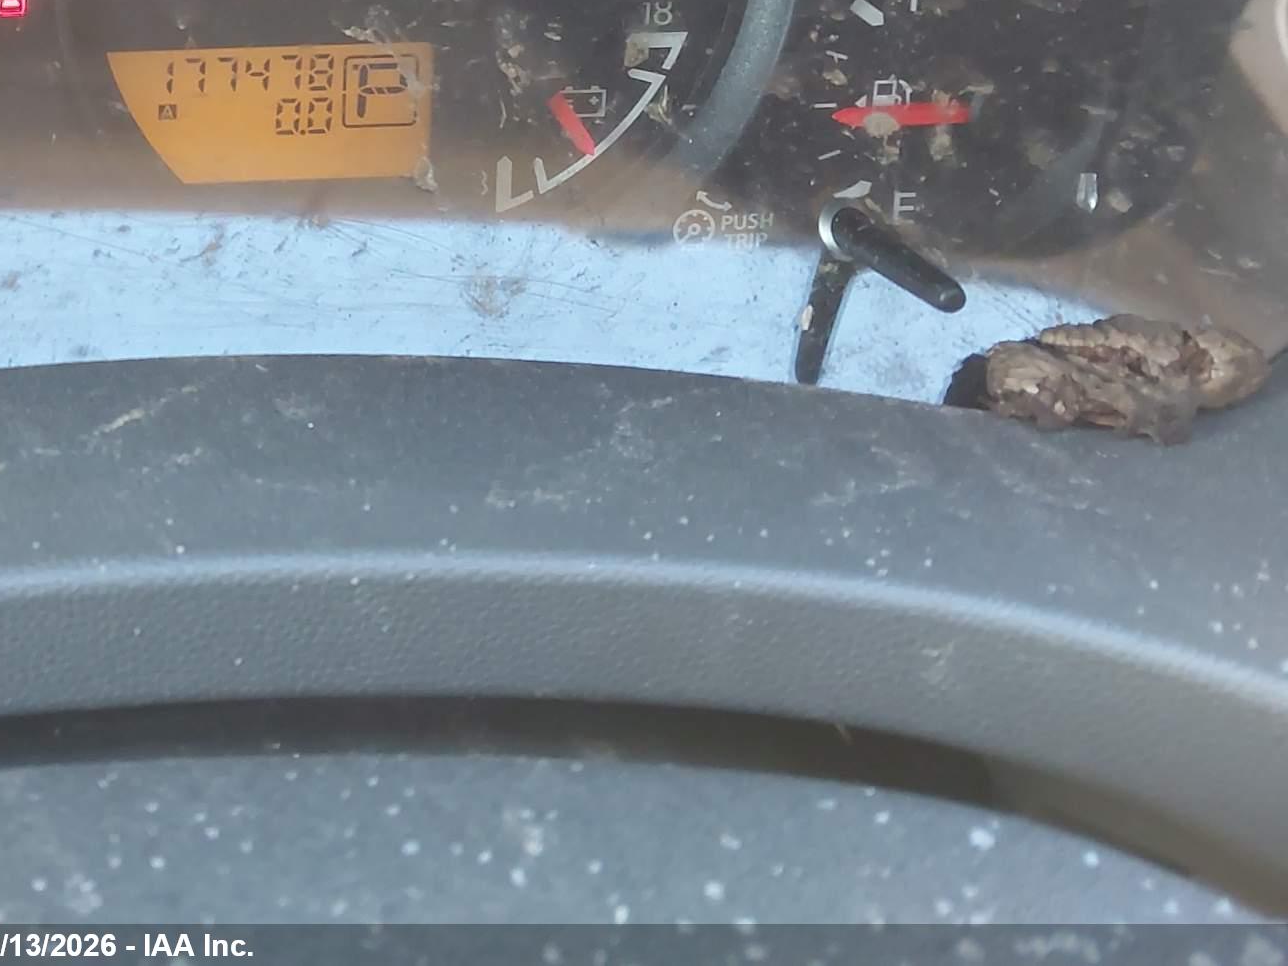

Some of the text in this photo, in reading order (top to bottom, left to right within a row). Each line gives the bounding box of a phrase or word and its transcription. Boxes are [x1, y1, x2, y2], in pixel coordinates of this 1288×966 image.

[642, 0, 673, 26] 18
[166, 53, 334, 94] 177478
[355, 62, 409, 119] P
[160, 105, 176, 120] A
[276, 97, 333, 136] 0.0
[720, 212, 775, 232] PUSH
[892, 189, 917, 225] E
